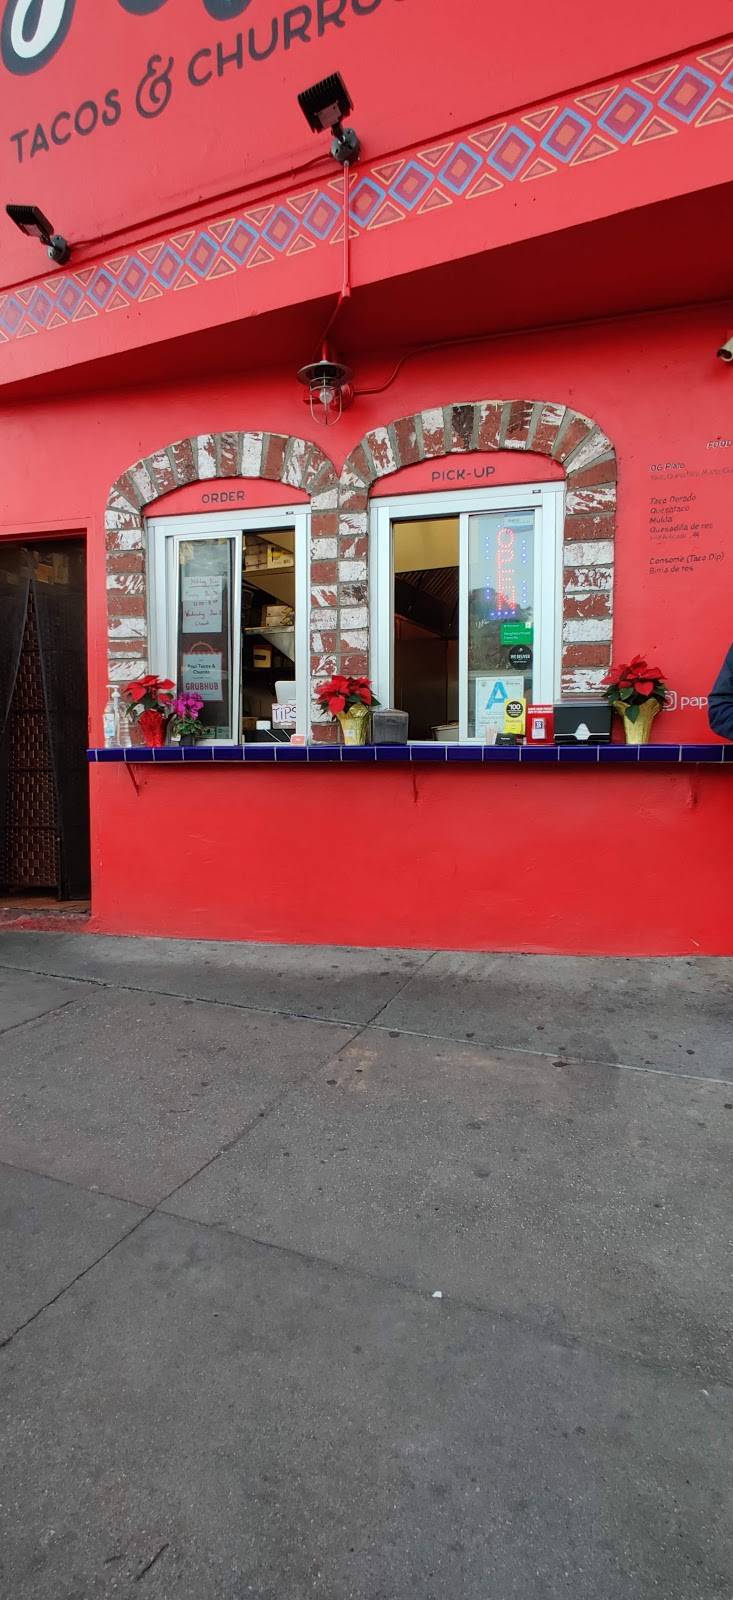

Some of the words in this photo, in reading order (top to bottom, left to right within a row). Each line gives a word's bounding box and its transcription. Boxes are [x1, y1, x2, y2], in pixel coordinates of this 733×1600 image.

[10, 88, 122, 164] TACOS
[135, 54, 174, 119] &
[431, 466, 496, 482] PICK-UP
[201, 490, 247, 504] ORDER
[496, 527, 516, 611] OPEN
[185, 682, 219, 690] GRUBHUB
